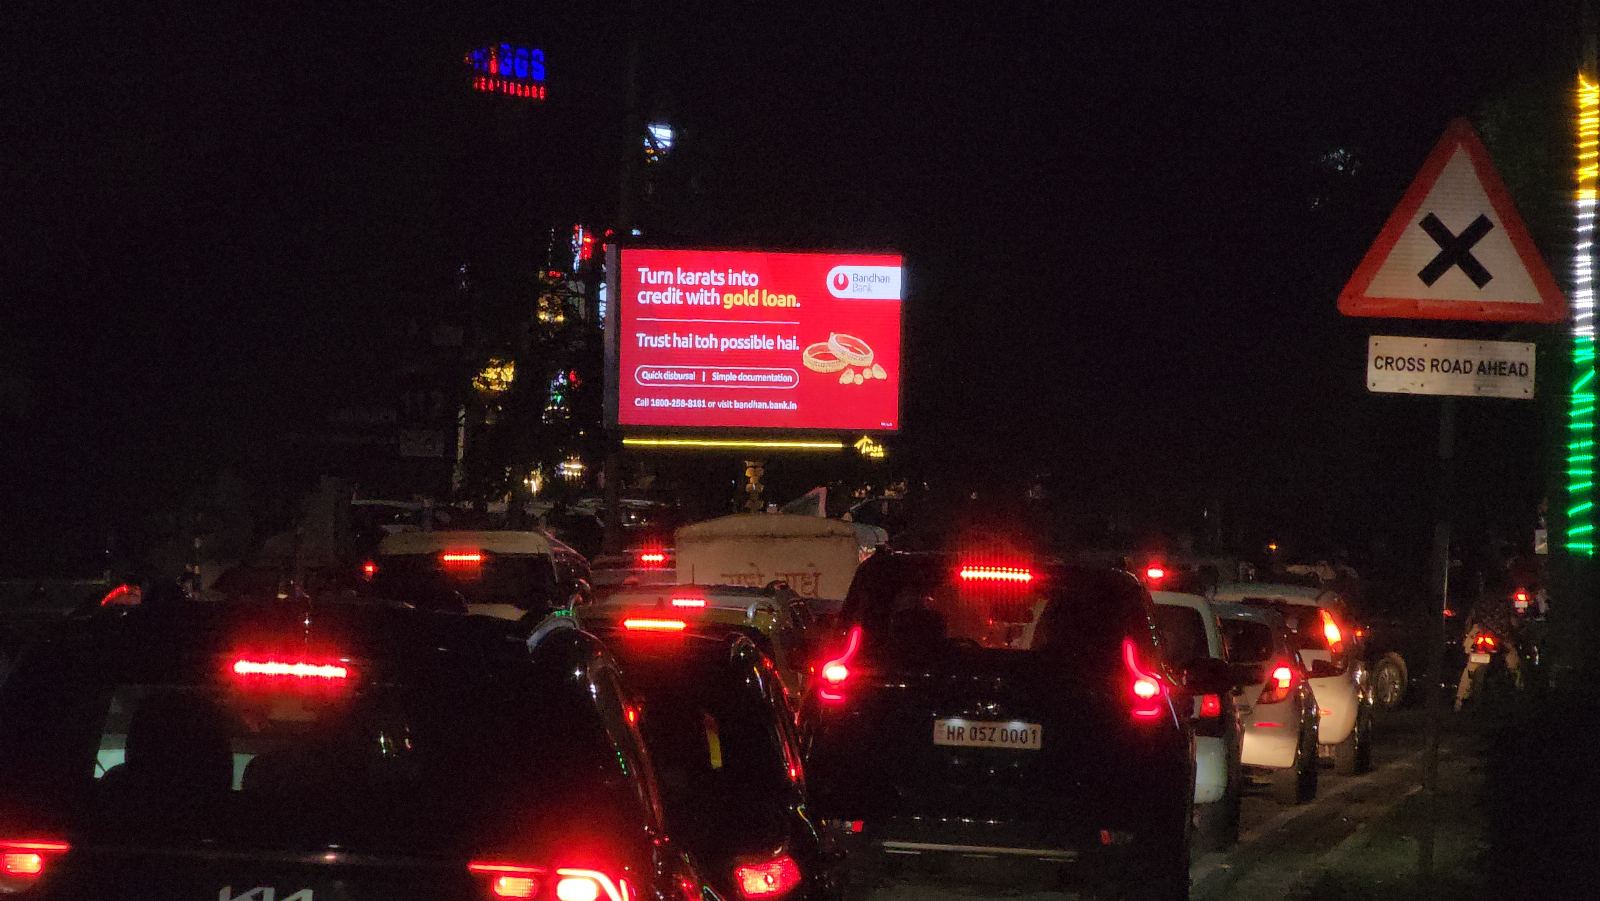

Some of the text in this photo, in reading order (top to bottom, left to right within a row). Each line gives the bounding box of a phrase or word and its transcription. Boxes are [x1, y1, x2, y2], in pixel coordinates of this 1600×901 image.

[637, 267, 759, 287] Turn karats into
[852, 272, 890, 284] Bandhan
[637, 287, 801, 310] credit with gold loan.
[636, 332, 800, 352] Trust hai toh possible hai.
[641, 370, 696, 381] Quick disbursal
[1374, 355, 1529, 378] CROSS ROAD AHEAD
[711, 371, 793, 383] Simple documentation
[634, 397, 650, 408] Call
[717, 399, 733, 409] visit
[734, 399, 797, 410] bandhan.bank.in
[947, 725, 965, 742] HR
[1001, 728, 1038, 745] 0001
